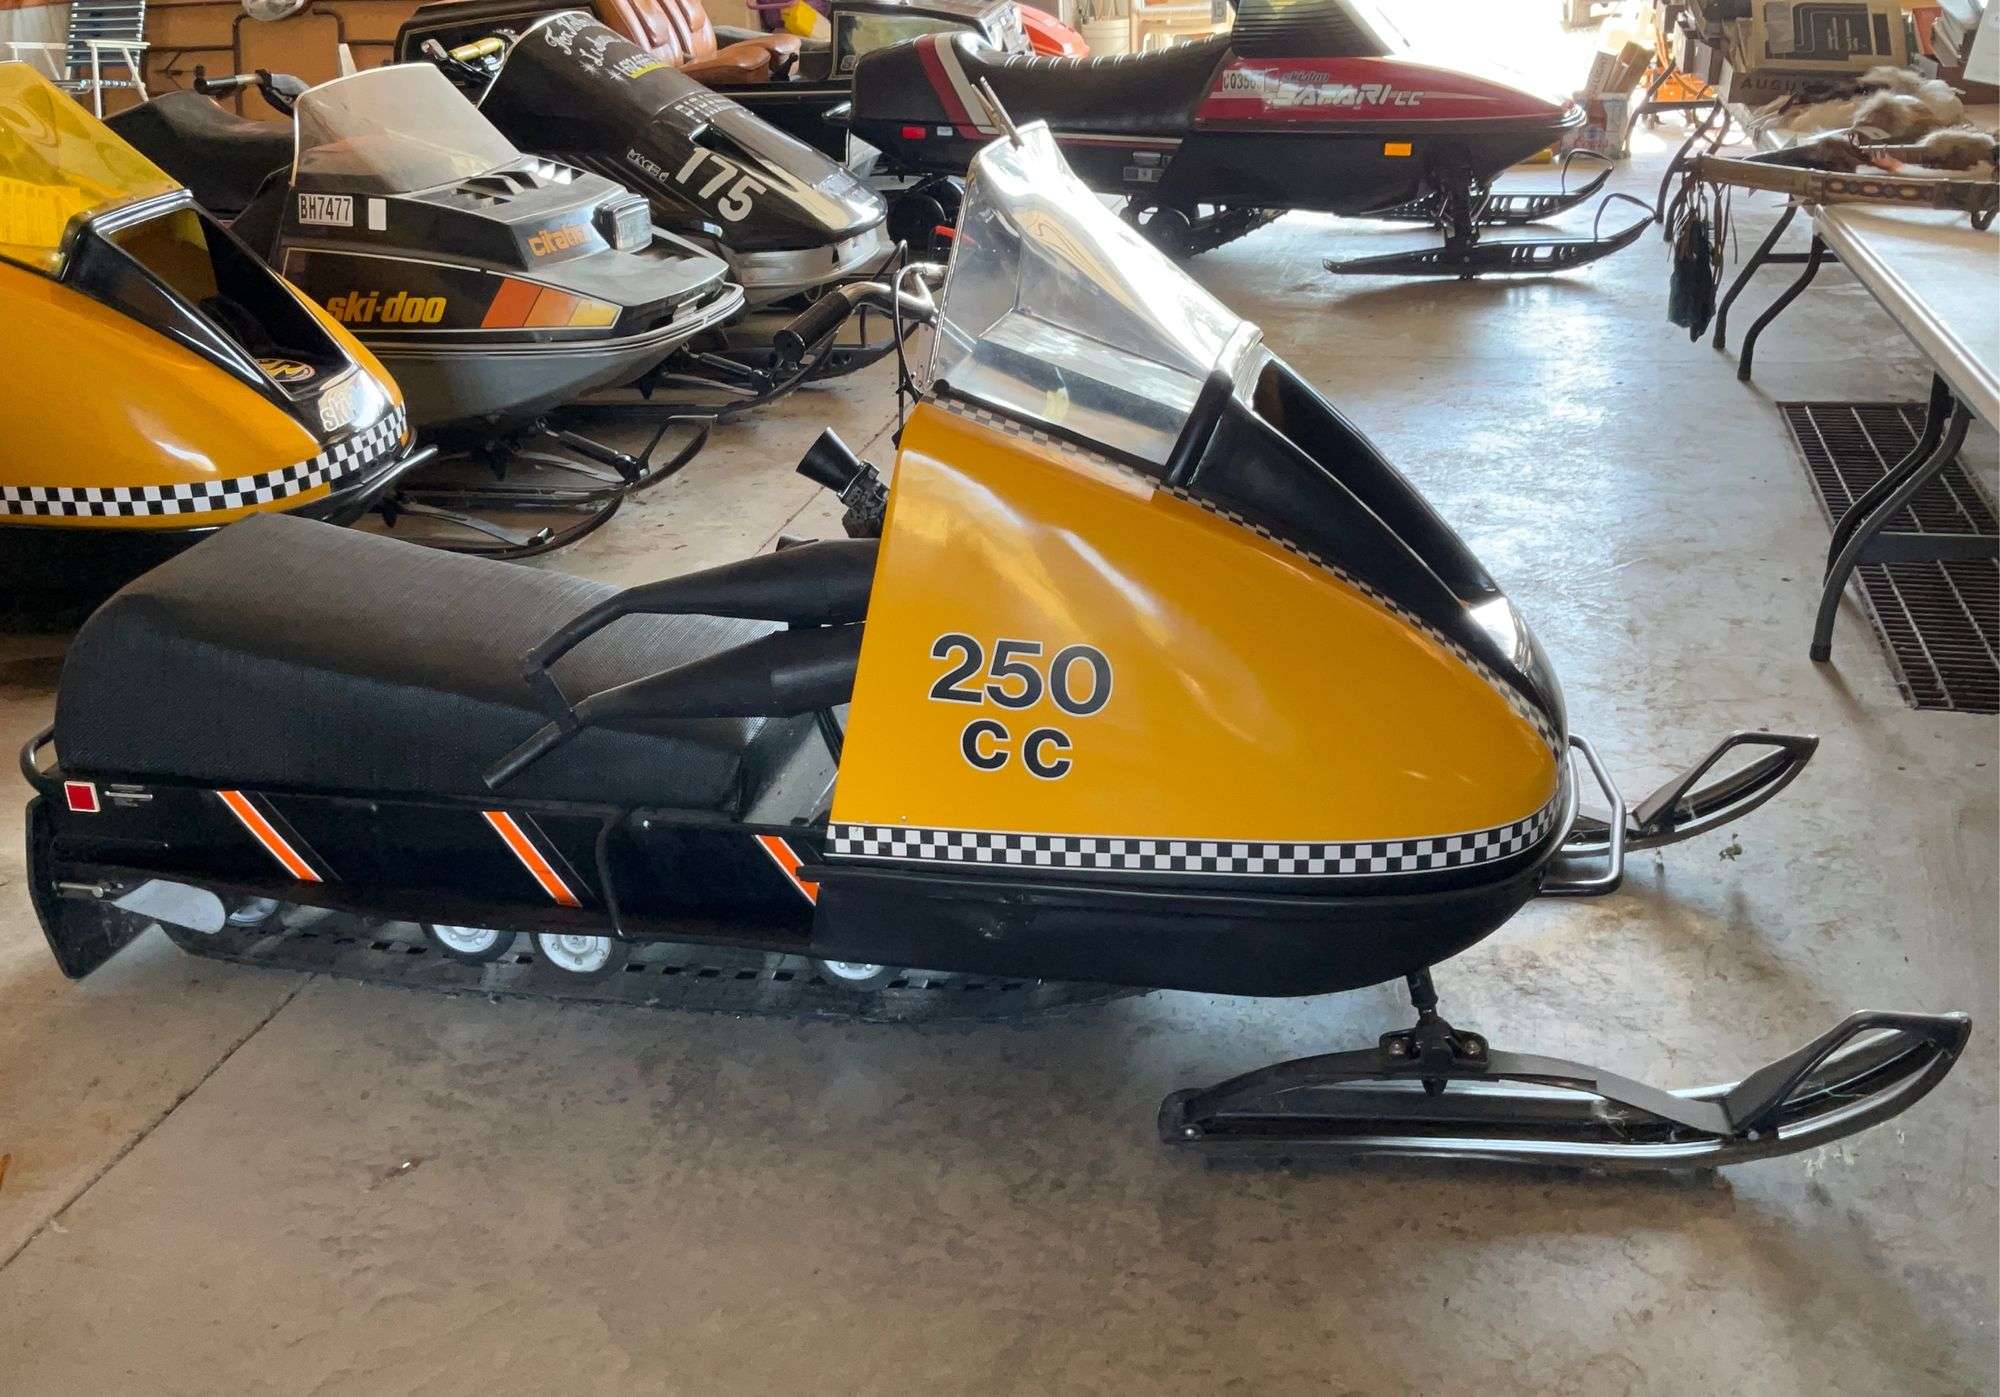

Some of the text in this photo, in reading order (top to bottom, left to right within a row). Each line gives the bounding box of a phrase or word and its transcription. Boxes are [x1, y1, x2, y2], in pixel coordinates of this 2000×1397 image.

[300, 195, 351, 221] BH7477
[675, 147, 767, 222] 175
[326, 291, 447, 323] ski-doo
[928, 631, 1114, 718] 250
